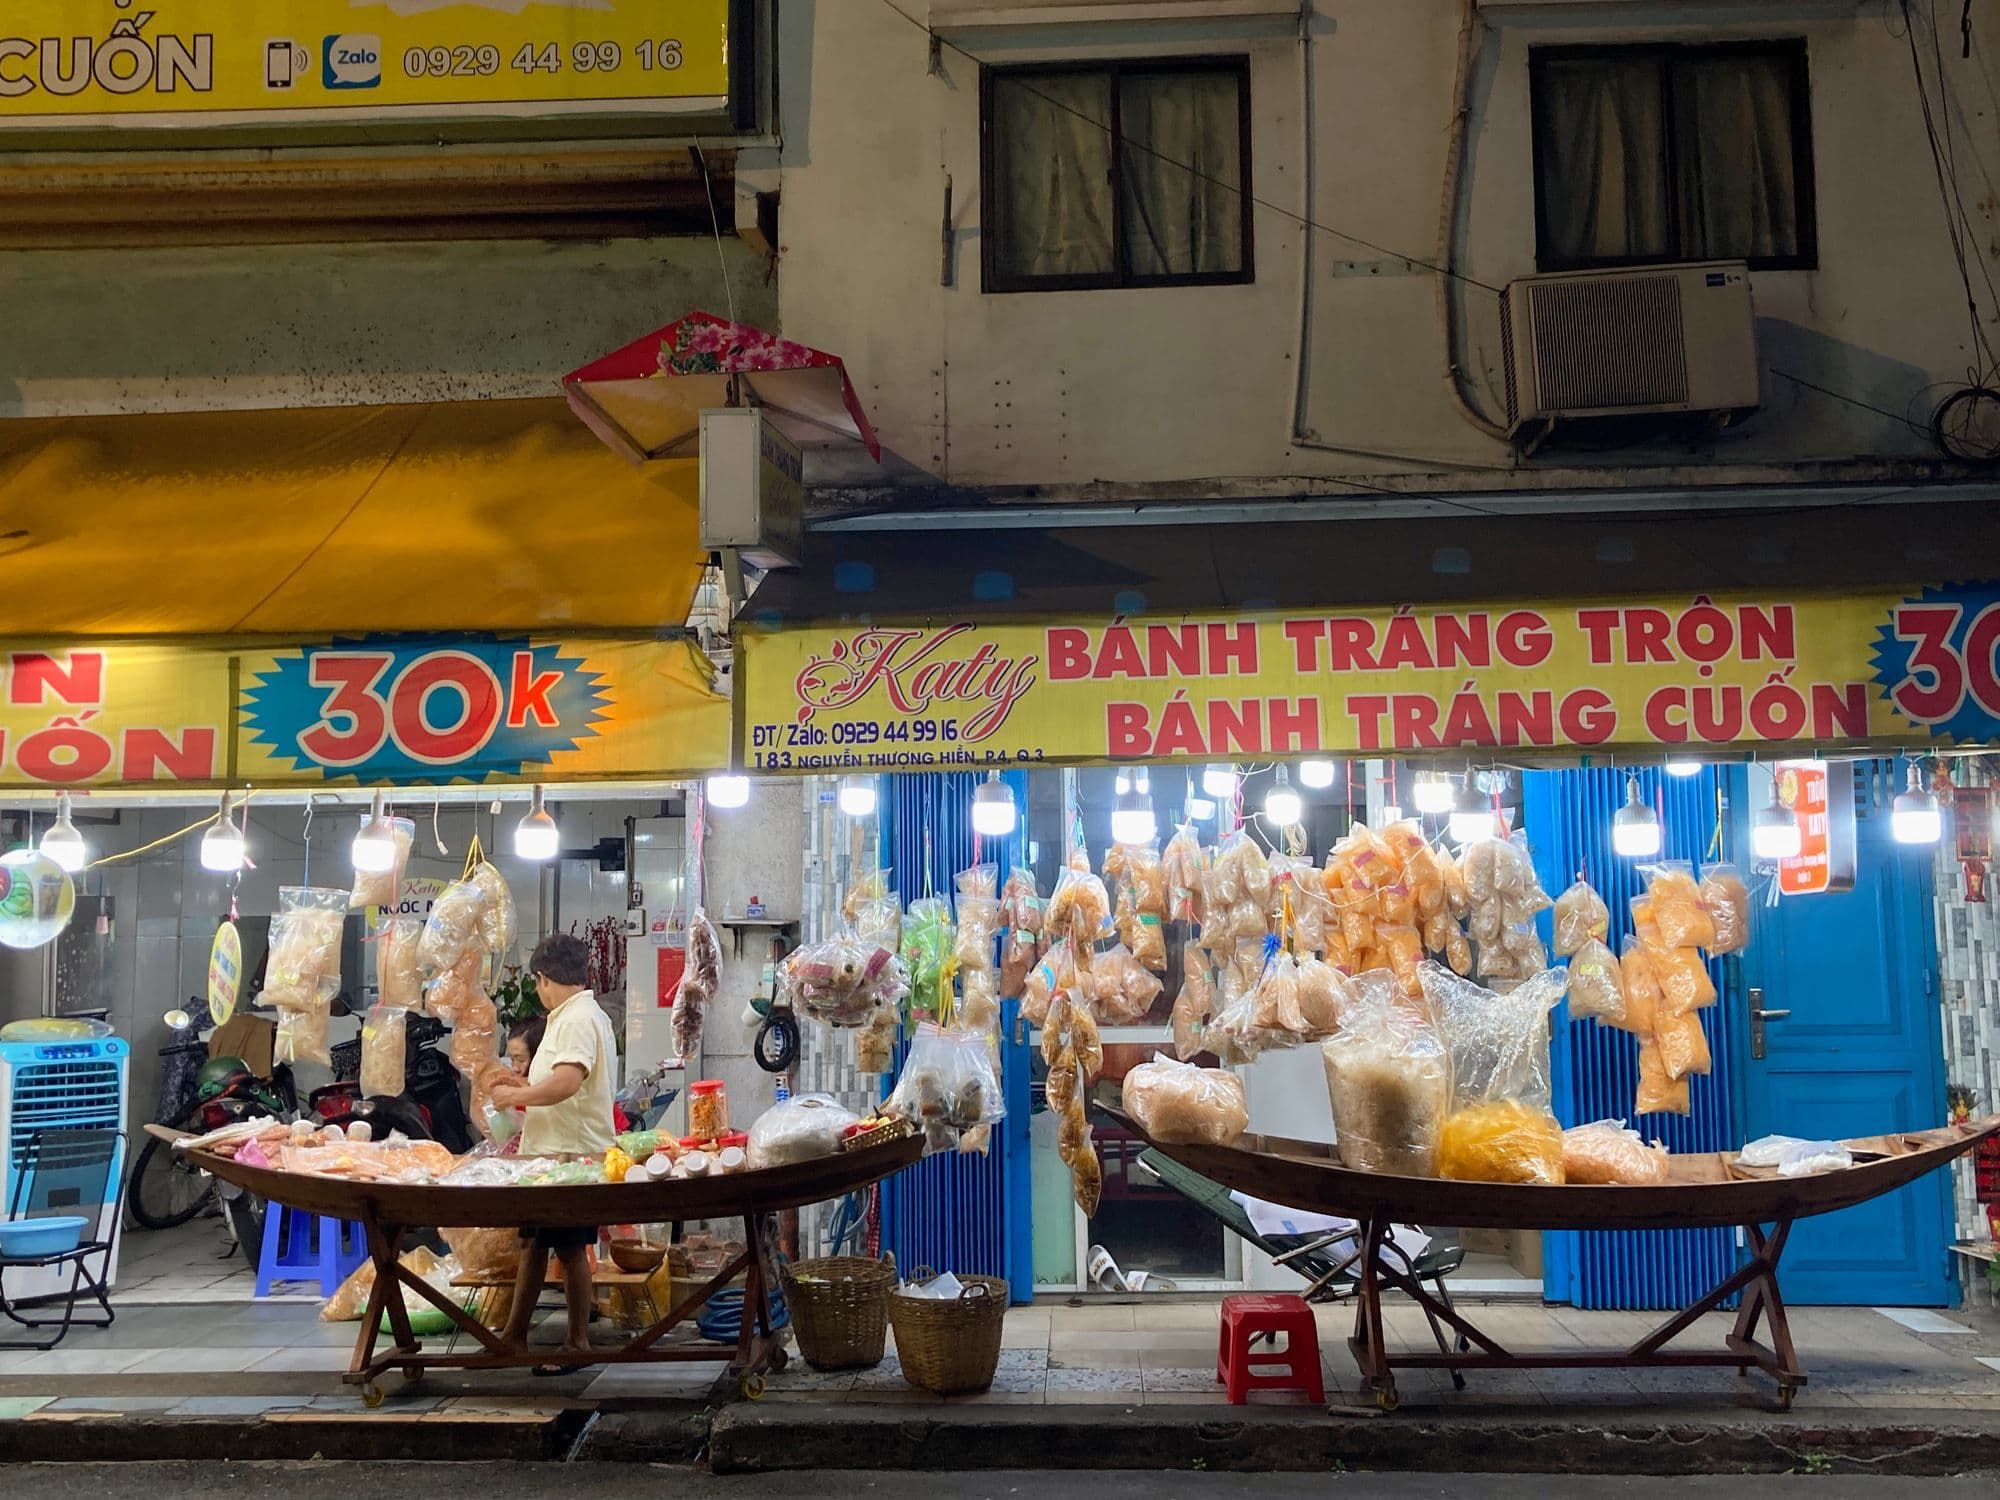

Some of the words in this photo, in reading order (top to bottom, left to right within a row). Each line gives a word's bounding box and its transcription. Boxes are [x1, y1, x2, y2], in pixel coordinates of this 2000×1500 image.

[0, 11, 213, 97] CUỐN
[338, 50, 377, 65] Zalo
[403, 45, 500, 78] 0929
[511, 43, 561, 73] 44
[572, 41, 622, 72] 99
[635, 39, 683, 70] 16
[1048, 615, 1258, 680] BÁNH
[1285, 605, 1553, 672] TRÁNG
[1578, 595, 1796, 678] TRỘN
[796, 621, 1038, 743] Katy
[1107, 689, 1320, 757] BÁNH
[1348, 681, 1617, 750] TRÁNG
[1646, 666, 1868, 743] CUỐN
[0, 709, 214, 783] ỐN
[754, 751, 792, 769] 183
[797, 748, 862, 768] NGUYỄN
[867, 750, 935, 769] THƯỢNG
[939, 744, 980, 765] HIỀN,
[1016, 748, 1045, 763] Q.3
[831, 722, 879, 744] 0929
[884, 721, 909, 743] 44
[912, 720, 937, 741] 99
[941, 719, 958, 741] 16
